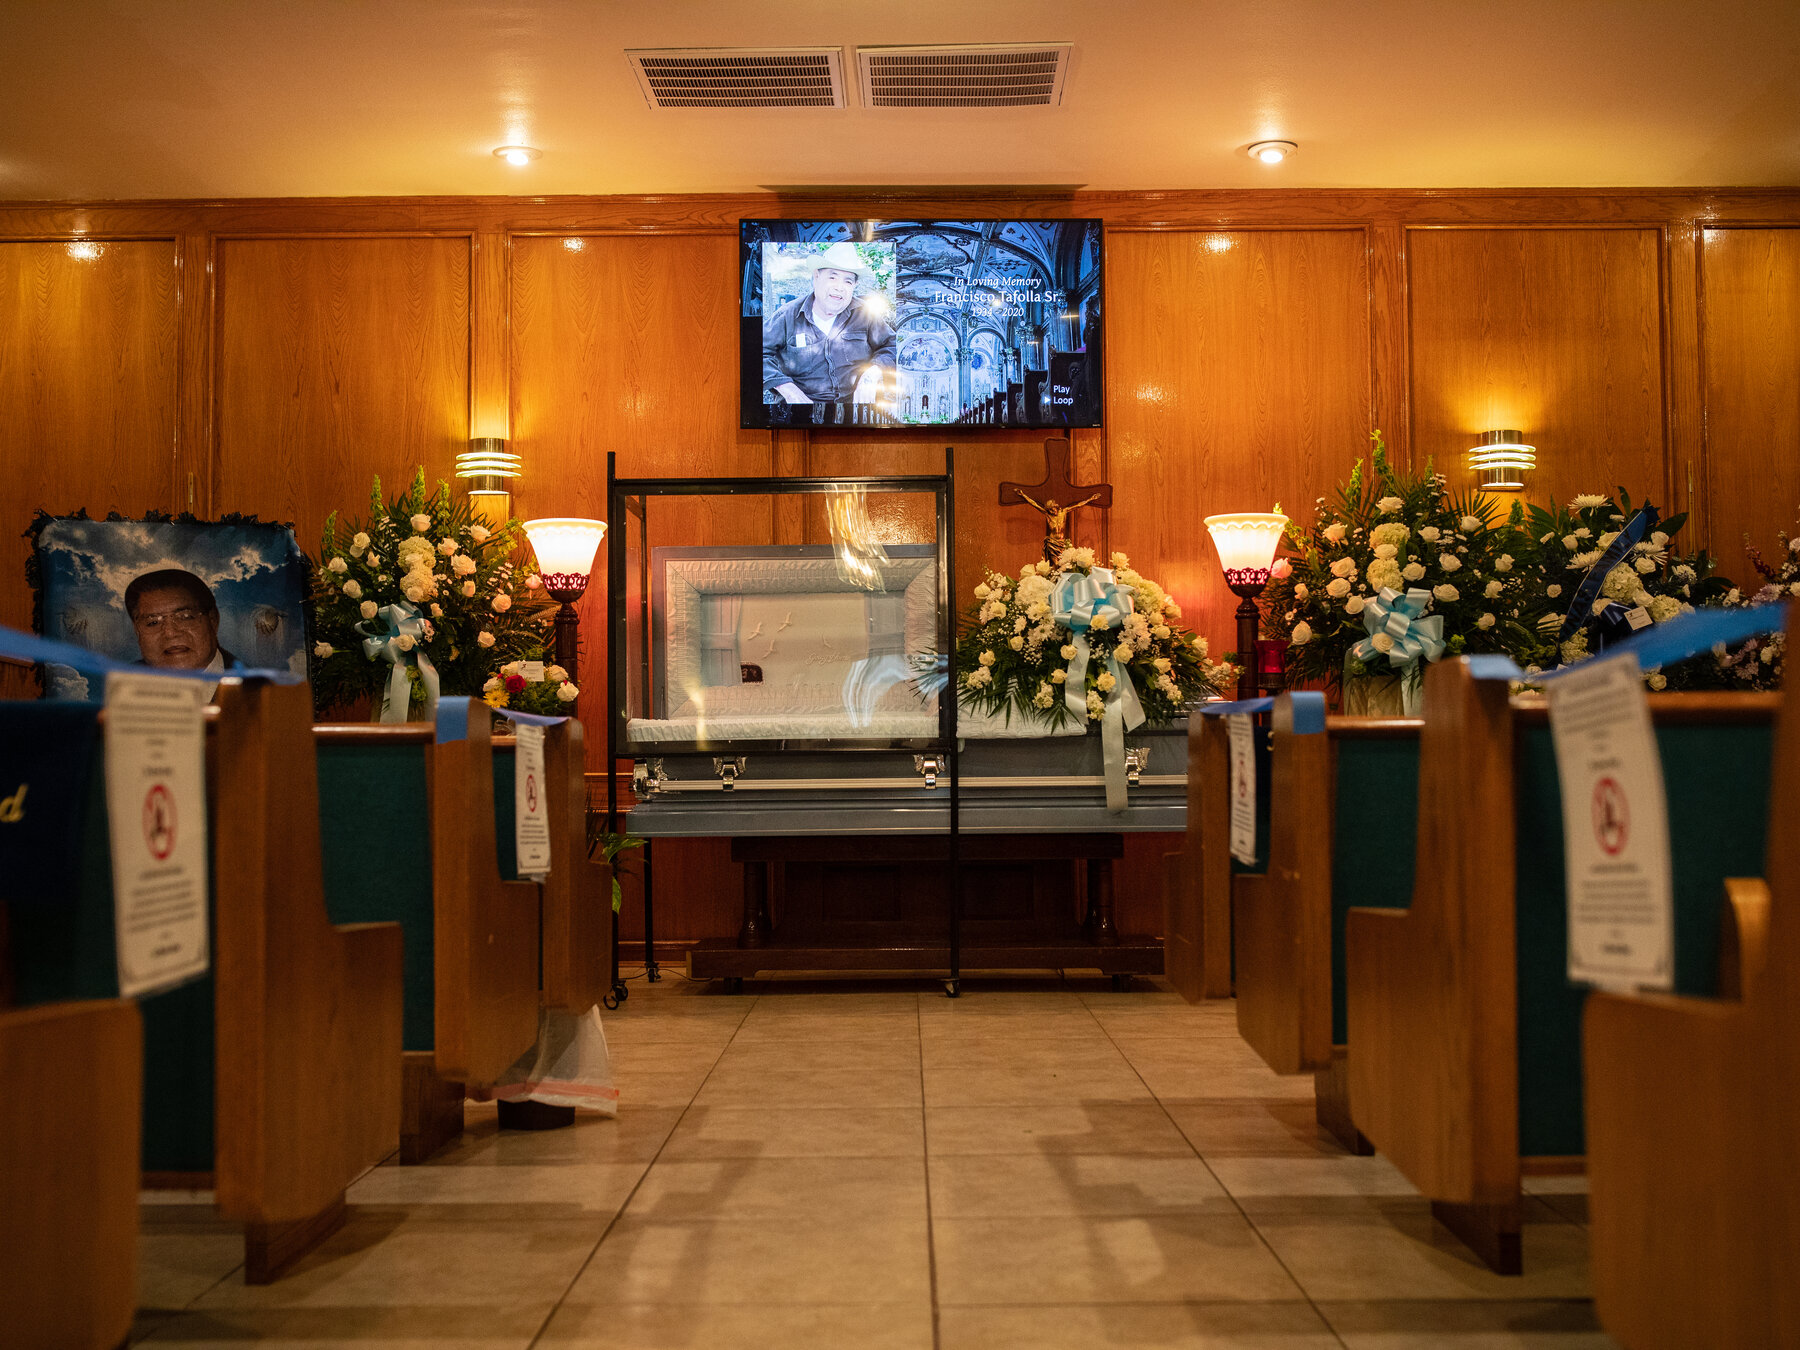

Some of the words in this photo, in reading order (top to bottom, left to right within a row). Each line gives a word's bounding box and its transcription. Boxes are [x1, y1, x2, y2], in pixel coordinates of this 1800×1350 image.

[953, 276, 964, 286] In
[967, 276, 999, 288] Loving
[1001, 276, 1042, 288] Memory
[935, 290, 995, 303] Francisco
[998, 290, 1041, 304] Tafolla
[1045, 291, 1061, 303] Sr.
[972, 308, 992, 317] 1934
[1002, 307, 1024, 317] 2020
[1053, 385, 1071, 395] Play
[1053, 396, 1074, 406] Loop
